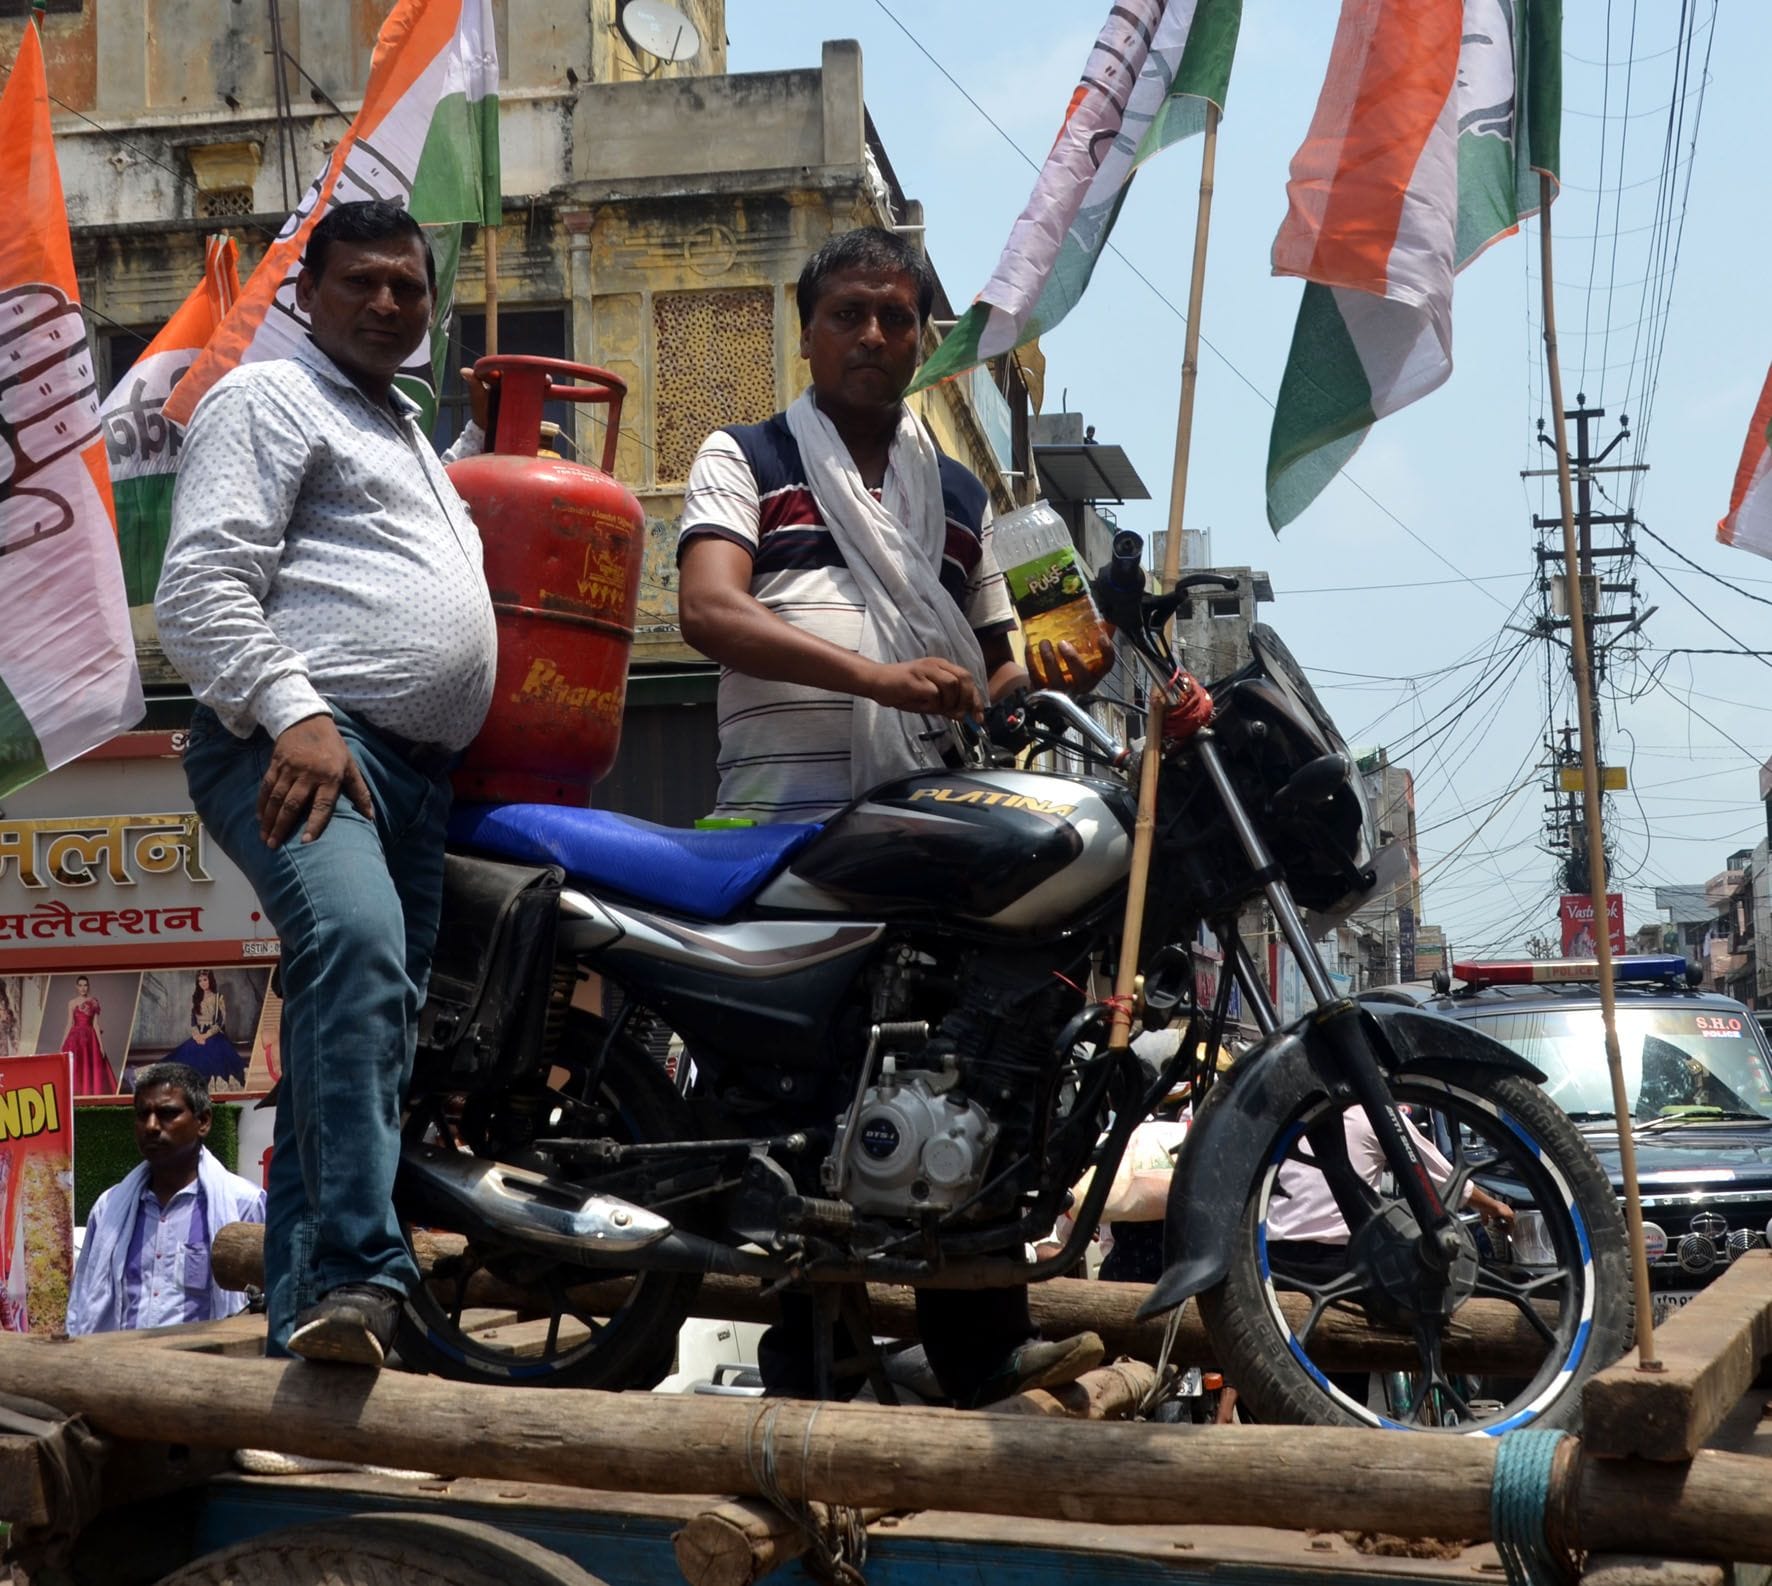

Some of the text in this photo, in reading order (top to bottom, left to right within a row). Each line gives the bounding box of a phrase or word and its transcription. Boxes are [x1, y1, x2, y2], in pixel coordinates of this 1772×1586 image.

[1028, 564, 1064, 595] PULSE
[908, 788, 1080, 817] PLATINA
[1552, 965, 1593, 976] POLICE
[1695, 1016, 1742, 1030] S.H.O
